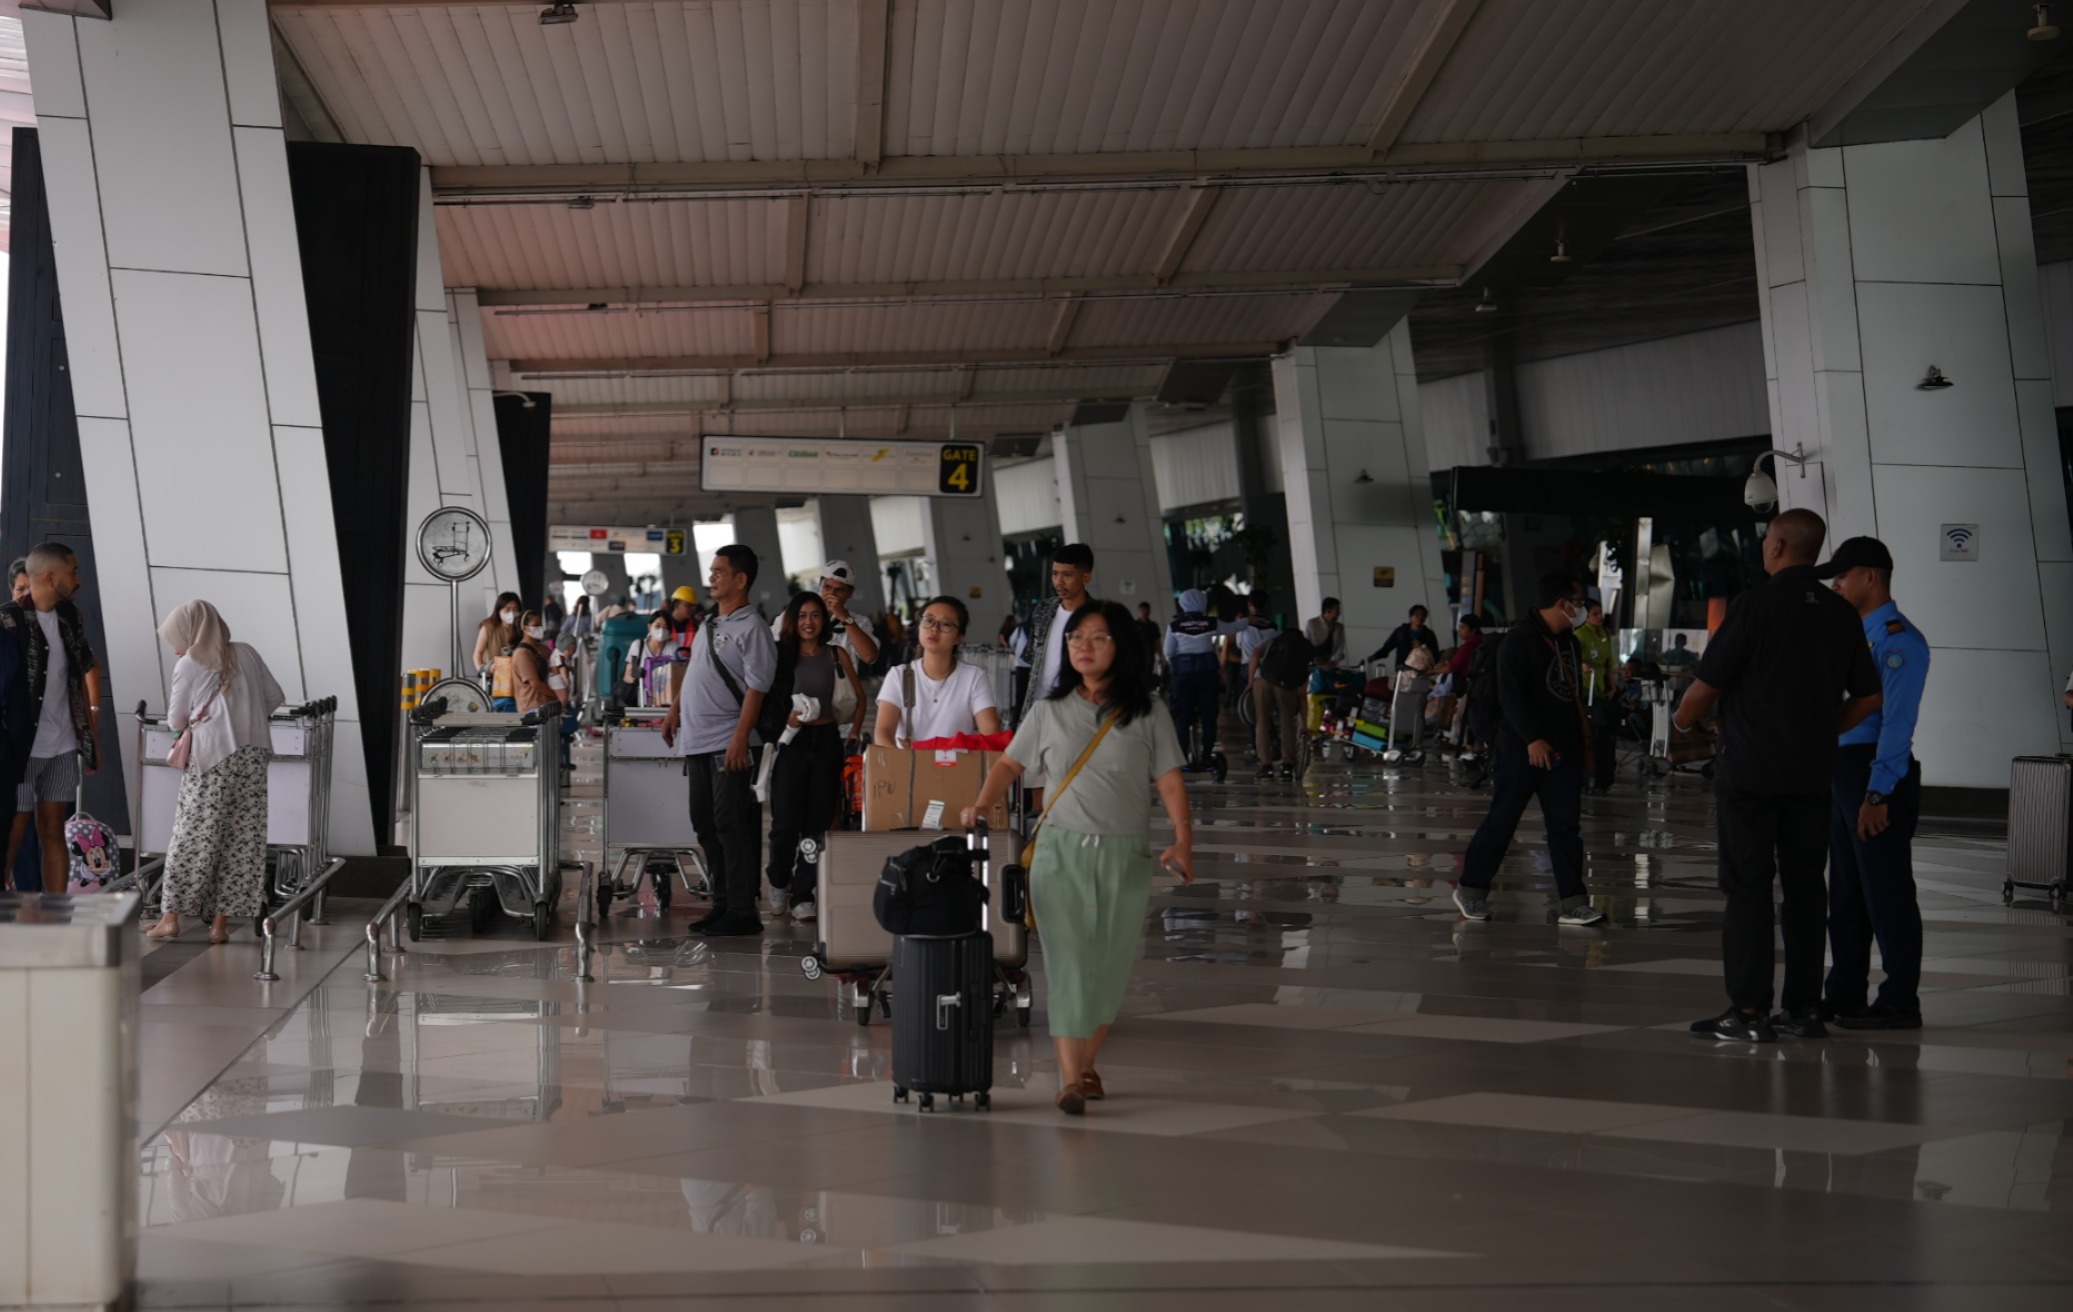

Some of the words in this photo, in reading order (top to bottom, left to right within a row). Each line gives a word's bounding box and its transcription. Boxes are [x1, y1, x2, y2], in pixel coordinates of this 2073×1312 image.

[943, 449, 977, 462] GATE
[947, 463, 969, 491] 4
[670, 538, 680, 553] 3
